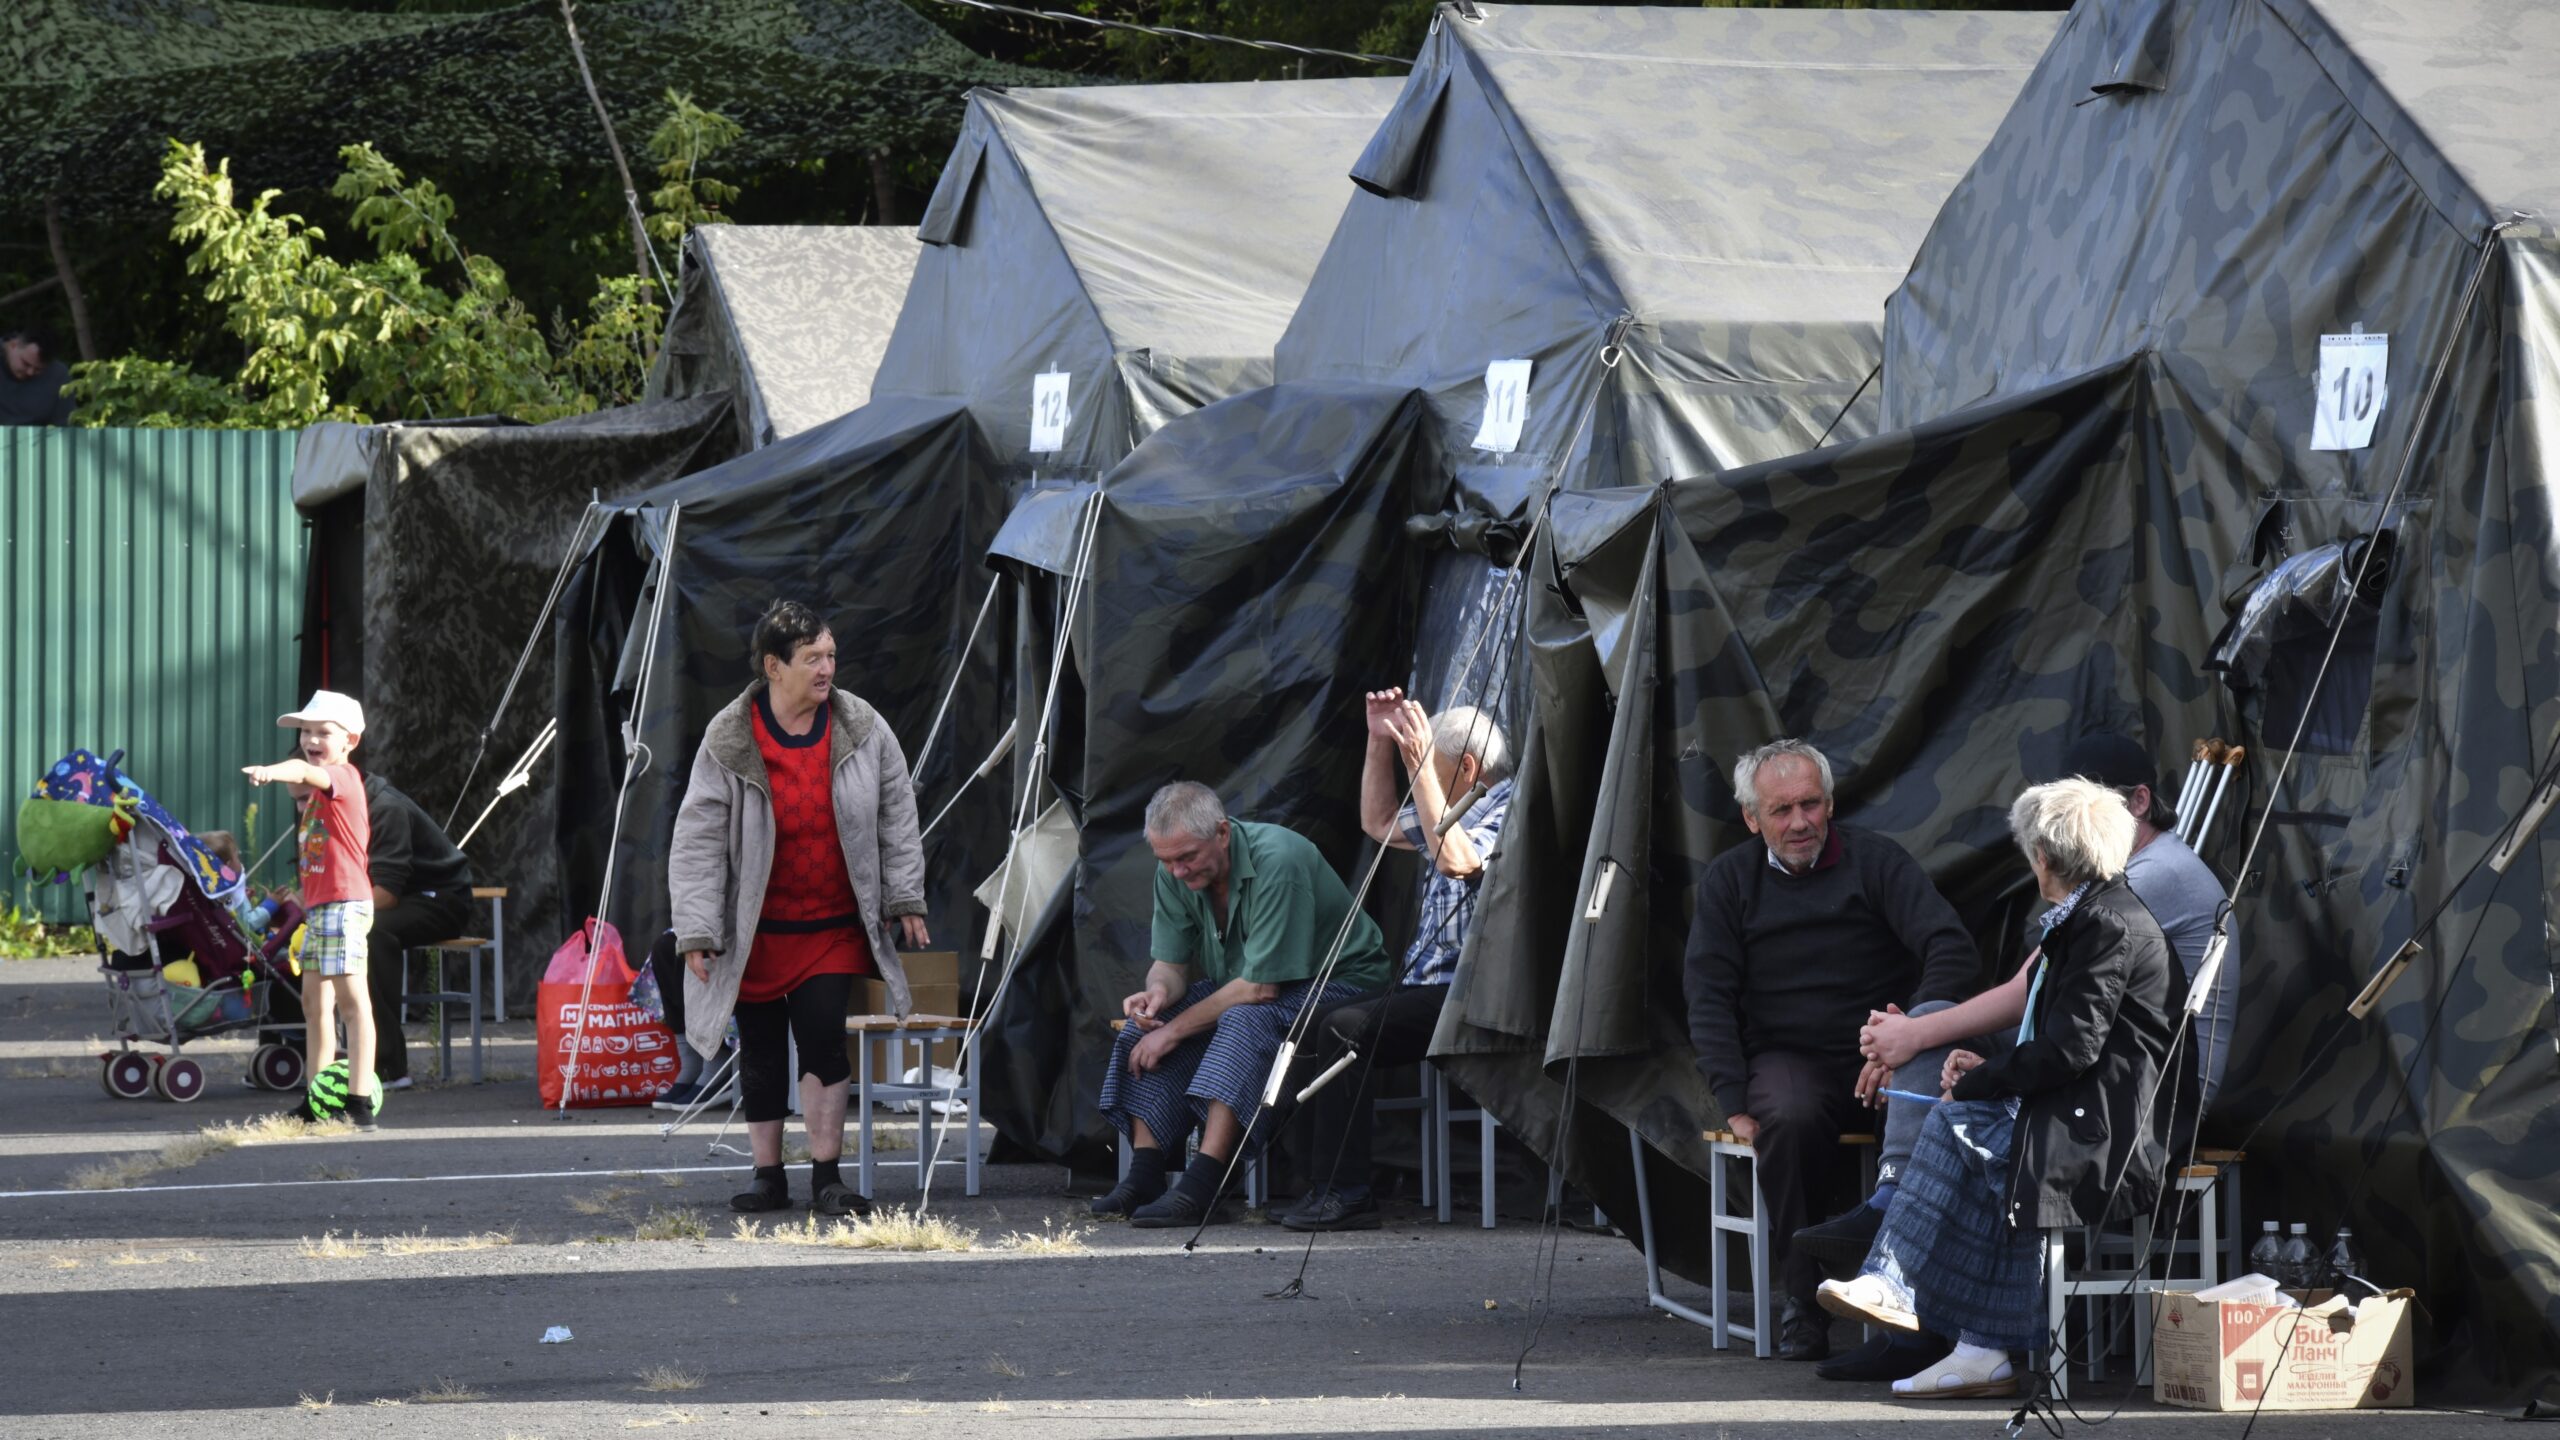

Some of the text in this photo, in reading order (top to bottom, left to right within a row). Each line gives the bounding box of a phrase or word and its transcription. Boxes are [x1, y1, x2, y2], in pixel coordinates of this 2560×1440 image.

[1493, 379, 1518, 424] 11
[2333, 366, 2374, 422] 10
[1041, 390, 1062, 428] 12
[588, 1002, 638, 1012] СЕМЬЯ МАГА
[588, 1010, 653, 1029] МАГНИ
[2227, 1309, 2254, 1326] 100
[2295, 1324, 2337, 1345] Биг
[2292, 1345, 2338, 1362] Ланч
